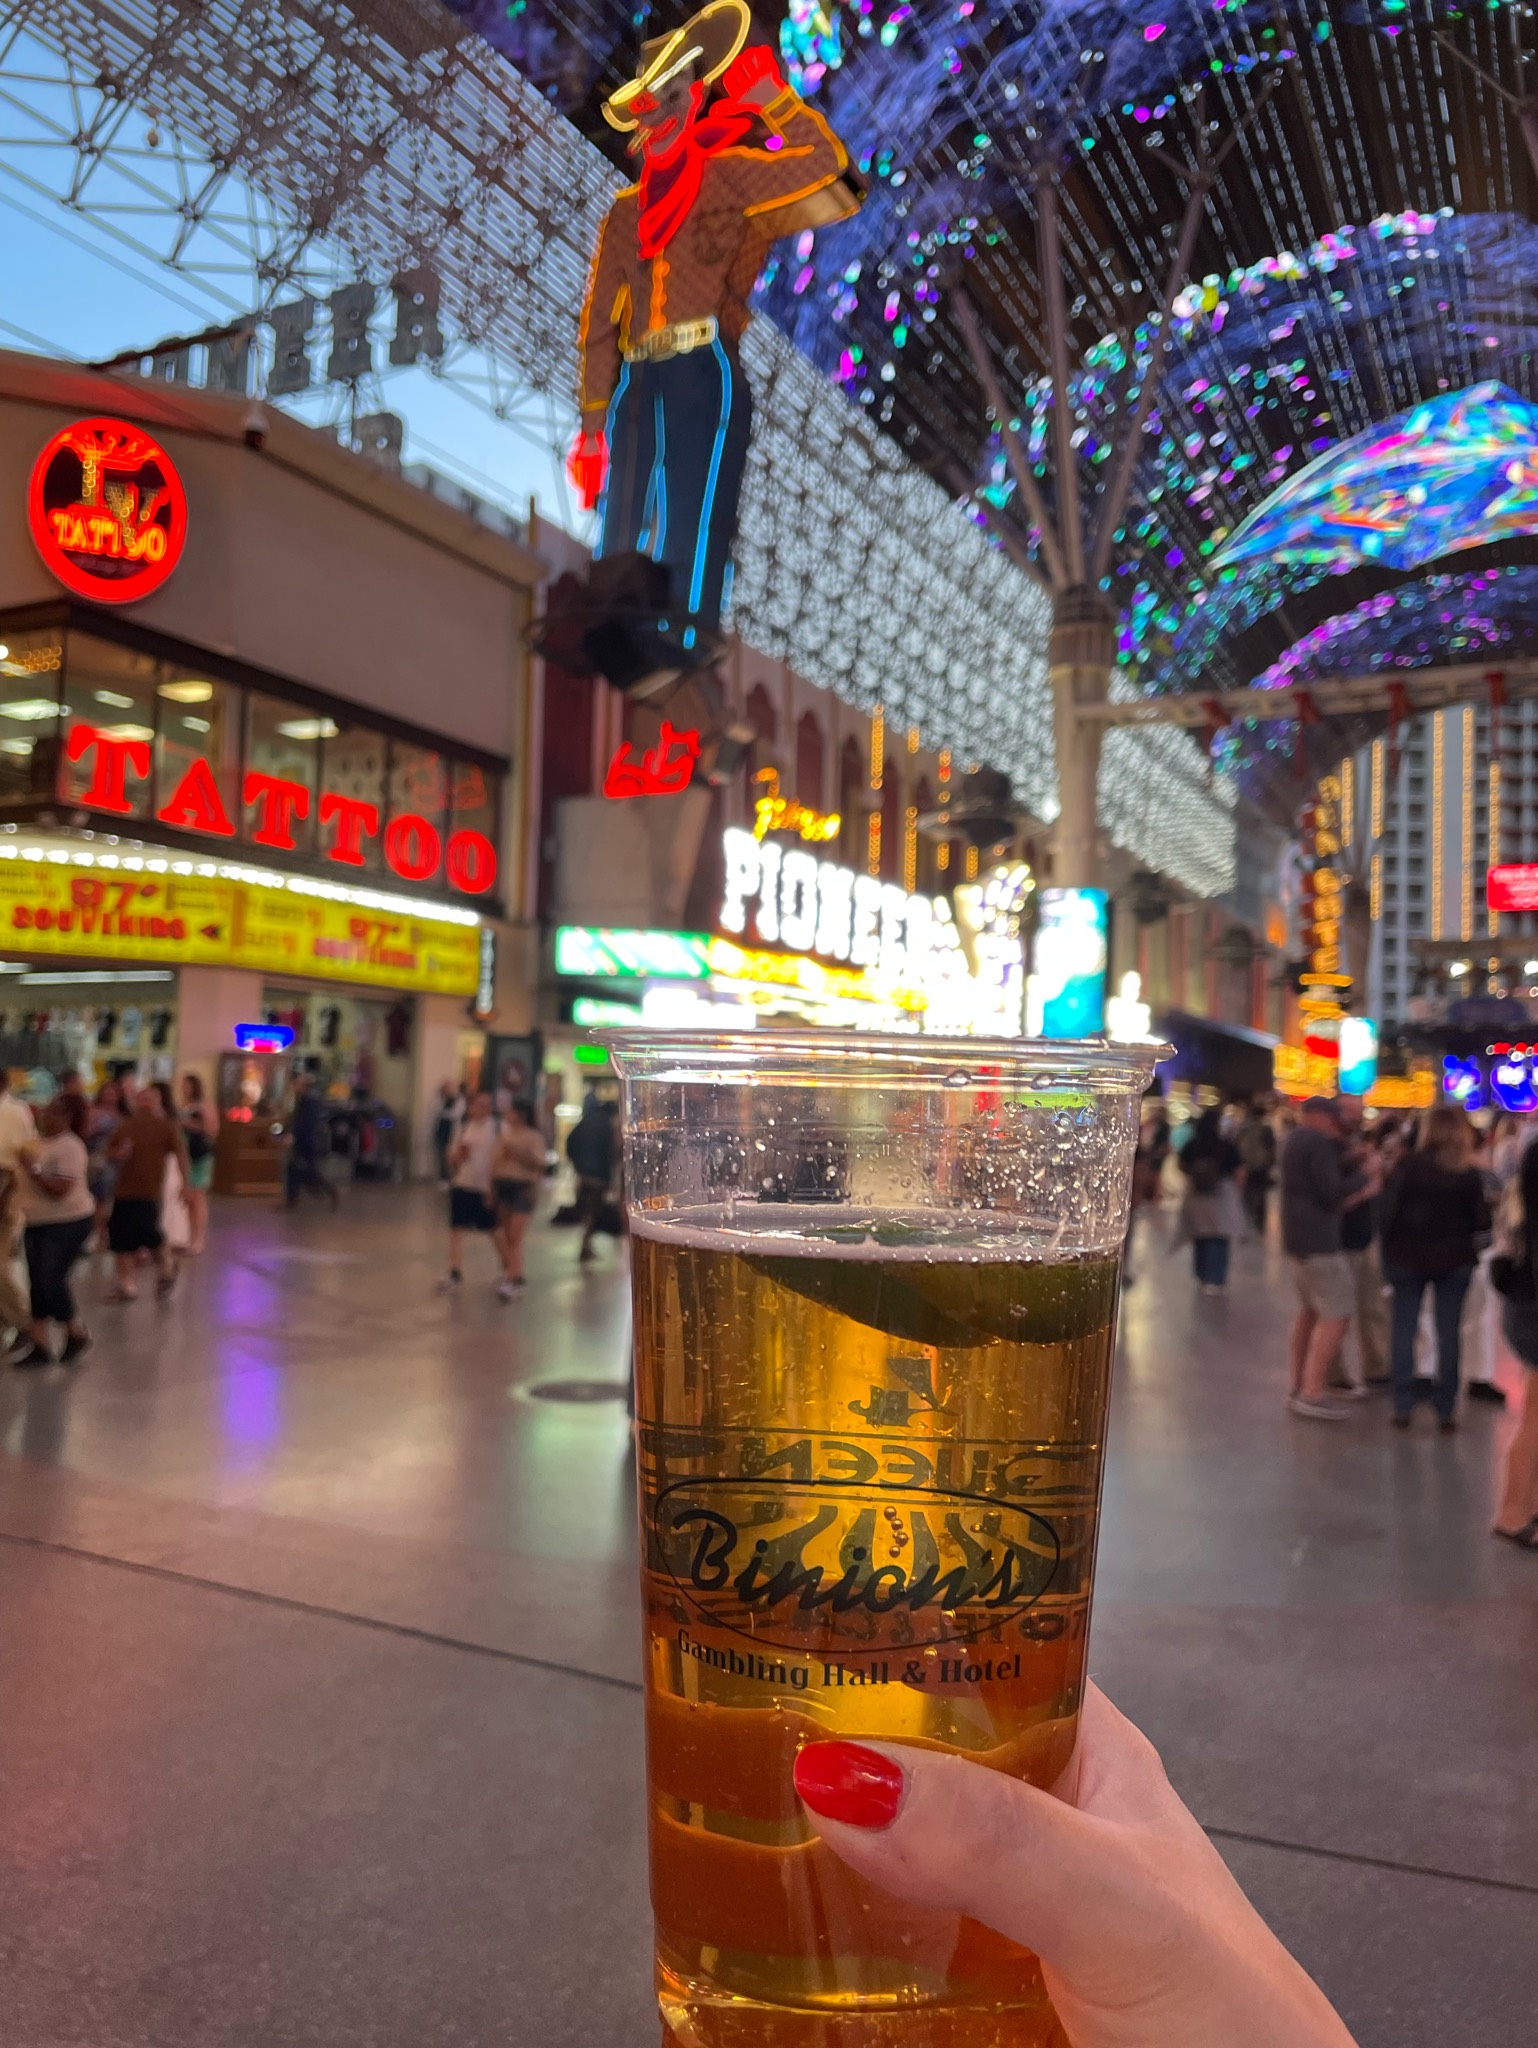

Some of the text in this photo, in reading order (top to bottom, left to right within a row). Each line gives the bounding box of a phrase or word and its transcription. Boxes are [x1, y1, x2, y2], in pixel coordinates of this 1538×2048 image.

[68, 723, 497, 895] TATTOO
[673, 1508, 1025, 1614] Binion's
[676, 1628, 1023, 1690] Gambling Hall & Hotel
